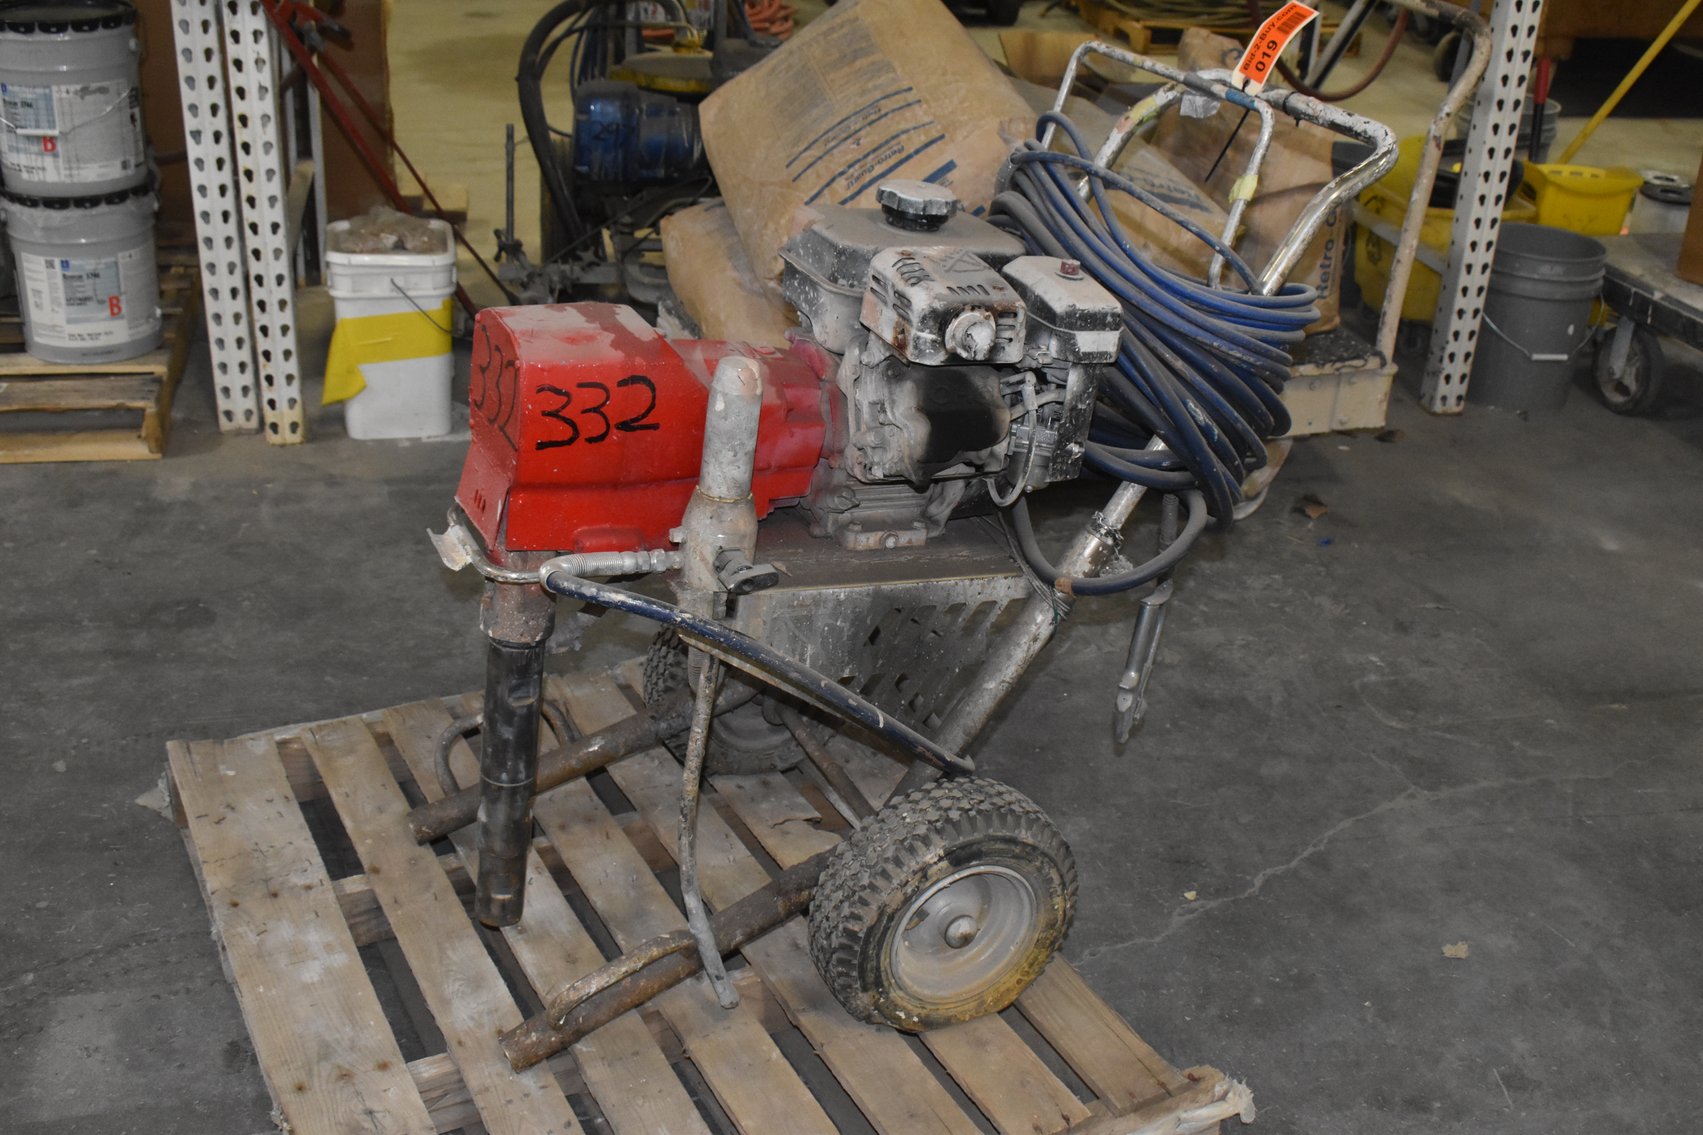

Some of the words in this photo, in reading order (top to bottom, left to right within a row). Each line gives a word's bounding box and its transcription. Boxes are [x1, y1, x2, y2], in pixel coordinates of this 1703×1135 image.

[1243, 4, 1298, 71] Bid-2-Buy.com
[1255, 40, 1278, 73] 019
[108, 295, 122, 317] B
[535, 374, 660, 450] 332
